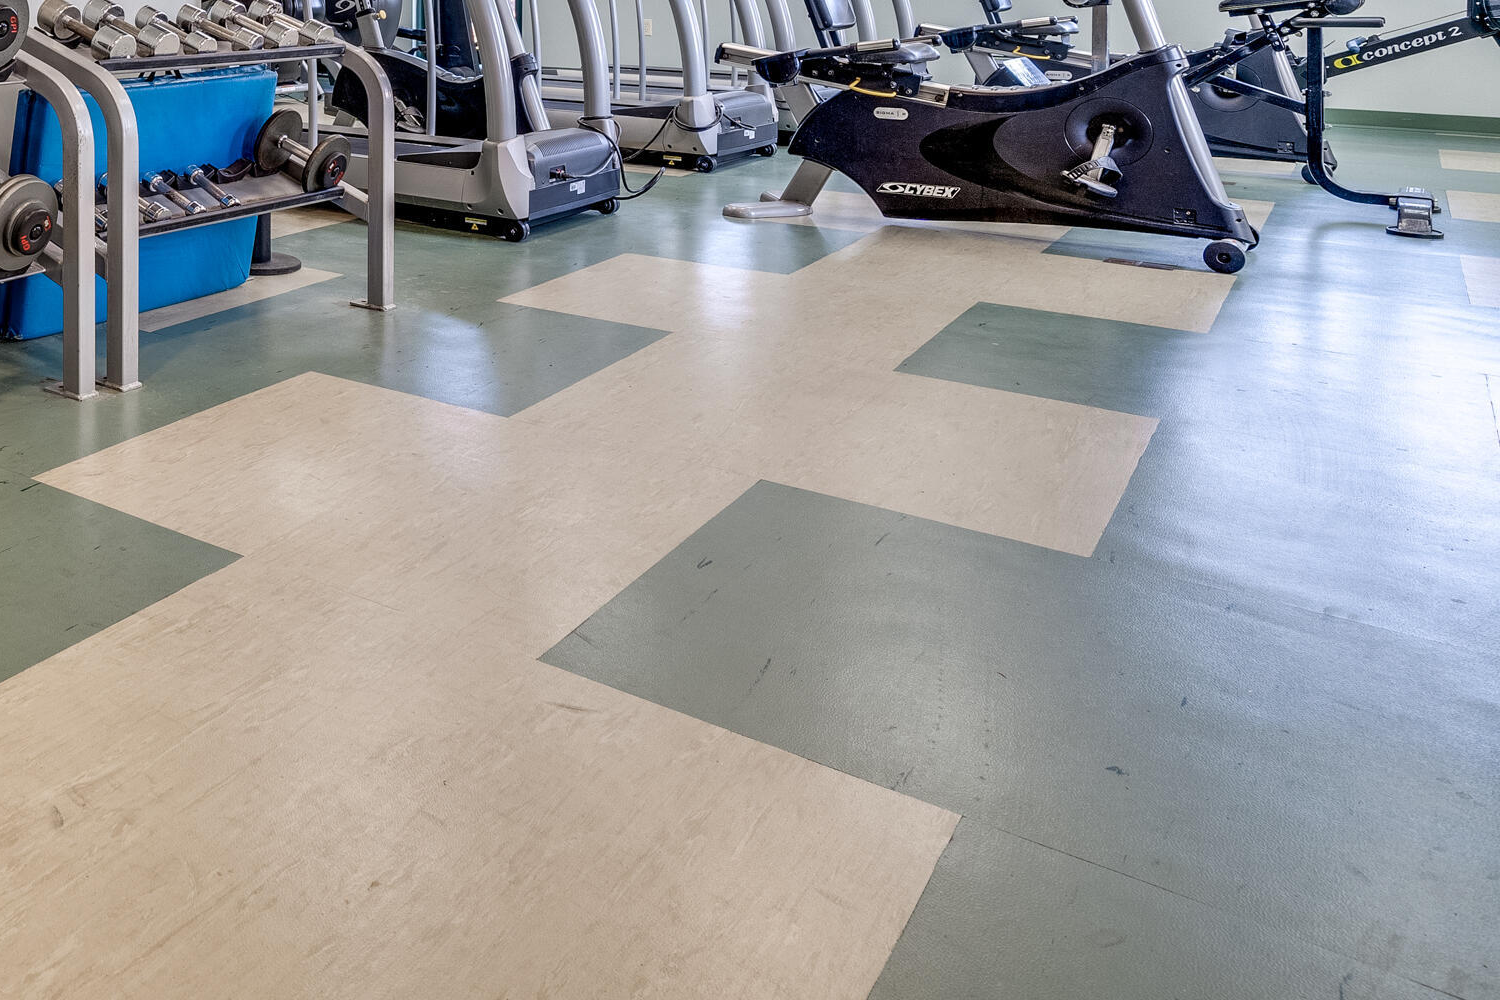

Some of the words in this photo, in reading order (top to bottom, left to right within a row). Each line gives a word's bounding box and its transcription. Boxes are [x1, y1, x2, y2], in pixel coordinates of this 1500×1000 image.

[1362, 31, 1446, 60] concept
[1448, 26, 1463, 37] 2
[903, 183, 954, 198] CYBEX
